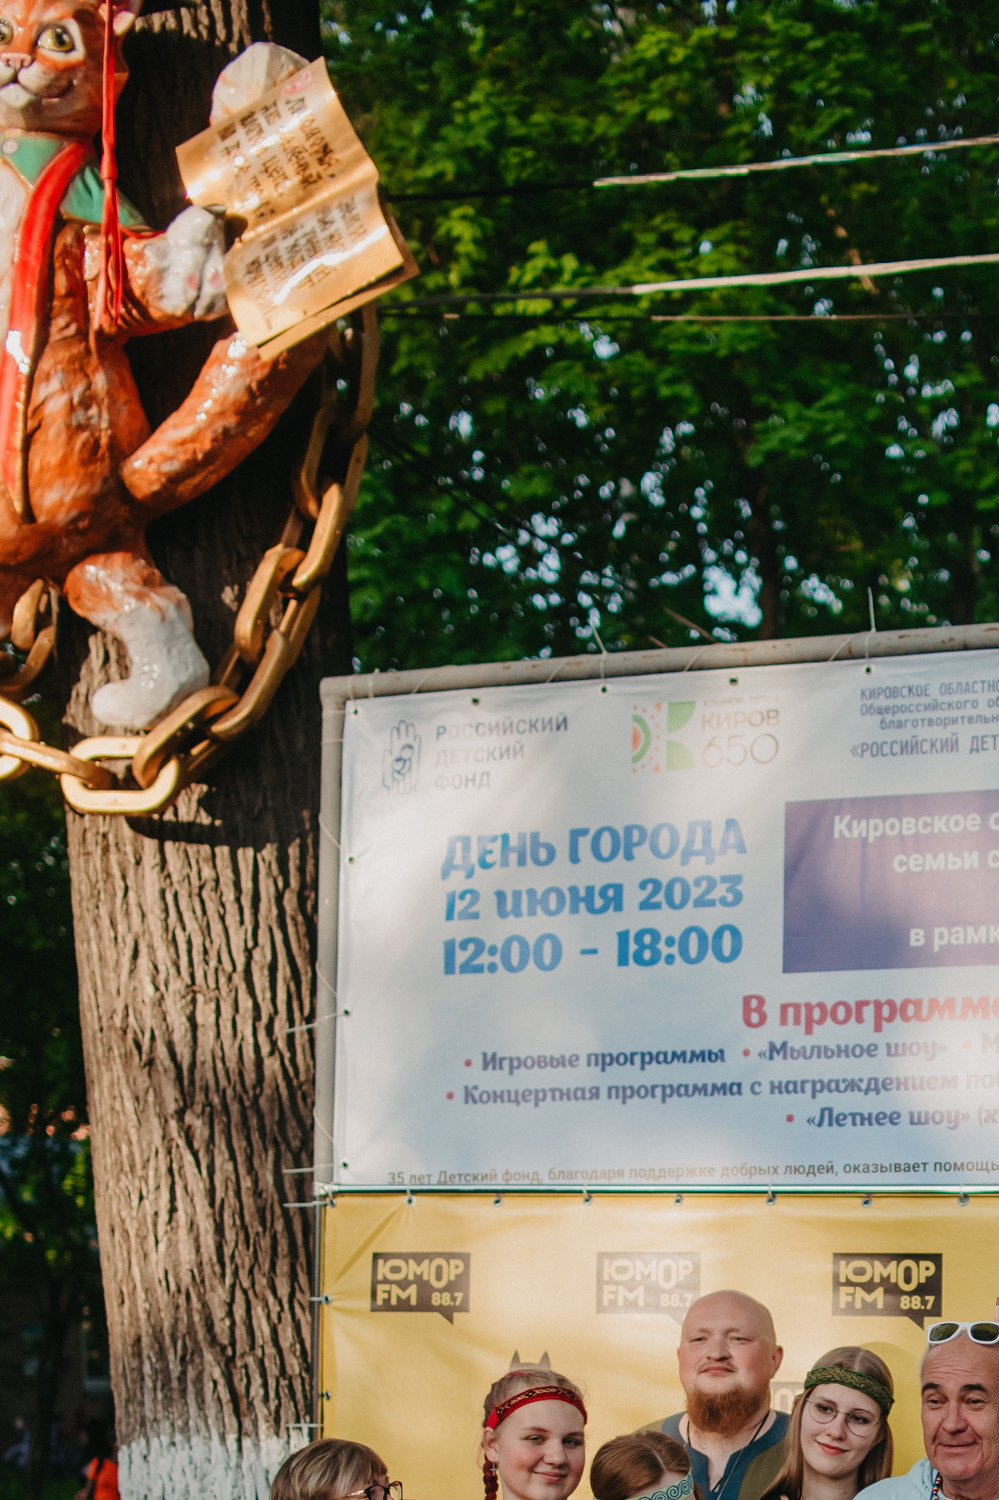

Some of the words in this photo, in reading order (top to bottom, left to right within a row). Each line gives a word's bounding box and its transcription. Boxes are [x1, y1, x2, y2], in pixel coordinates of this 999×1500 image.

[860, 684, 931, 701] КИРОВСКОЕ
[702, 709, 780, 731] КИРОВ
[860, 699, 979, 717] Общероссийского
[436, 711, 568, 740] РОССИЙСКИЙ
[434, 741, 524, 768] ДЕТСКИЙ
[702, 733, 780, 768] 650
[850, 732, 960, 758] «РОССИЙСКИЙ
[435, 771, 491, 790] ФОНД
[833, 812, 981, 843] Кировское
[441, 831, 557, 881] ДЕНЬ
[568, 818, 748, 867] ГОРОДА
[893, 849, 979, 874] семьи
[445, 888, 481, 922] 12
[493, 883, 624, 919] июня
[638, 874, 744, 911] 2023
[442, 932, 563, 976] 12:00
[616, 923, 743, 967] 18:00
[909, 926, 925, 947] в
[741, 994, 768, 1029] В
[481, 1050, 580, 1075] Игровые
[586, 1047, 727, 1073] программы
[757, 1040, 879, 1062] «Мыльное
[886, 1041, 948, 1062] шоу»
[463, 1085, 600, 1107] Концертная
[607, 1080, 743, 1105] программа
[750, 1081, 763, 1096] с
[769, 1073, 958, 1099] награждением
[806, 1106, 901, 1128] «Летнее
[909, 1109, 971, 1130] шоу»
[388, 1171, 405, 1184] 35
[408, 1173, 432, 1184] лет
[437, 1169, 497, 1184] Детский
[501, 1169, 543, 1184] фонд,
[549, 1166, 625, 1183] благодаря
[628, 1164, 716, 1181] поддержке
[720, 1161, 779, 1179] добрых
[784, 1160, 838, 1177] людей,
[843, 1161, 928, 1175] оказывает
[934, 1159, 999, 1174] помощь
[376, 1259, 465, 1287] ЮМОР
[602, 1258, 694, 1290] ЮМОР
[839, 1259, 936, 1292] ЮМОР
[376, 1285, 417, 1306] FM
[431, 1291, 464, 1306] 88.7
[660, 1293, 694, 1307] 88.7
[839, 1287, 884, 1309] FM
[900, 1295, 935, 1310] 88.7
